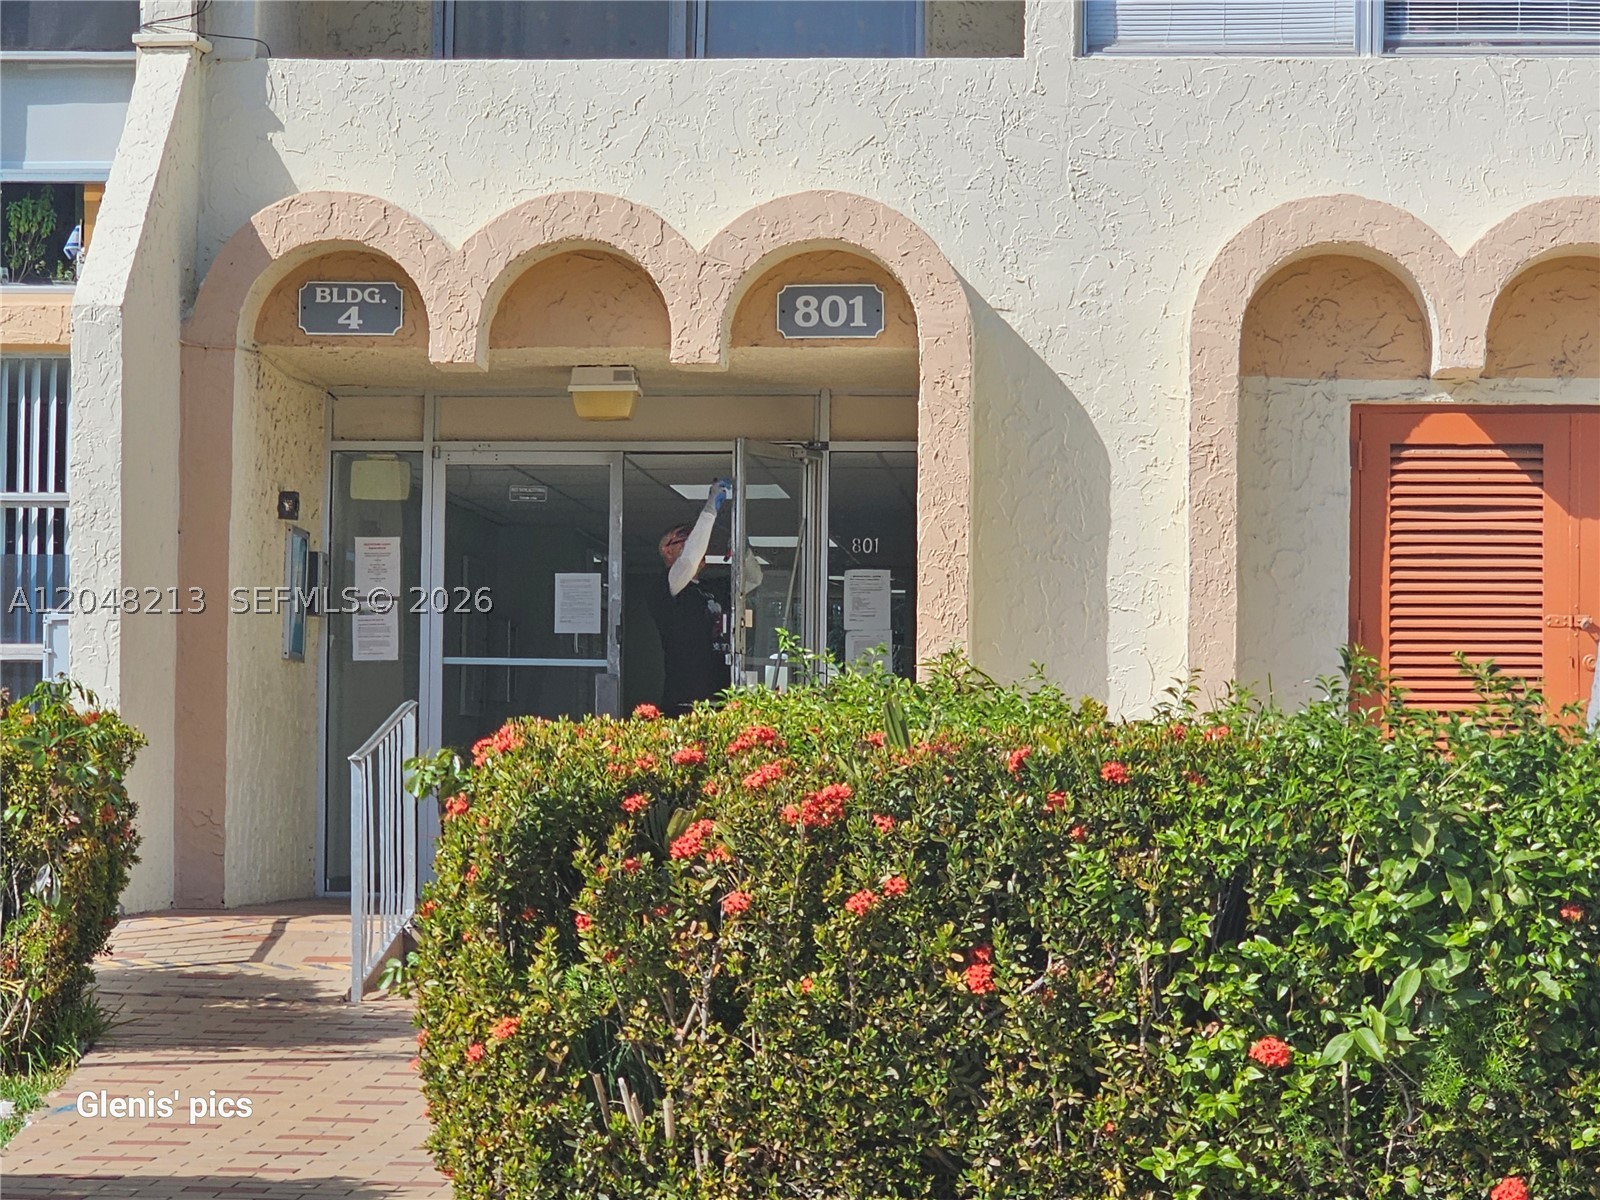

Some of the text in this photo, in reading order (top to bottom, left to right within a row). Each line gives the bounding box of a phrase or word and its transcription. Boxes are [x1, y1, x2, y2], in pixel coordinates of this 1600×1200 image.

[315, 287, 387, 304] BLDG.
[337, 306, 363, 330] 4
[794, 295, 867, 328] 801
[852, 537, 879, 554] 801
